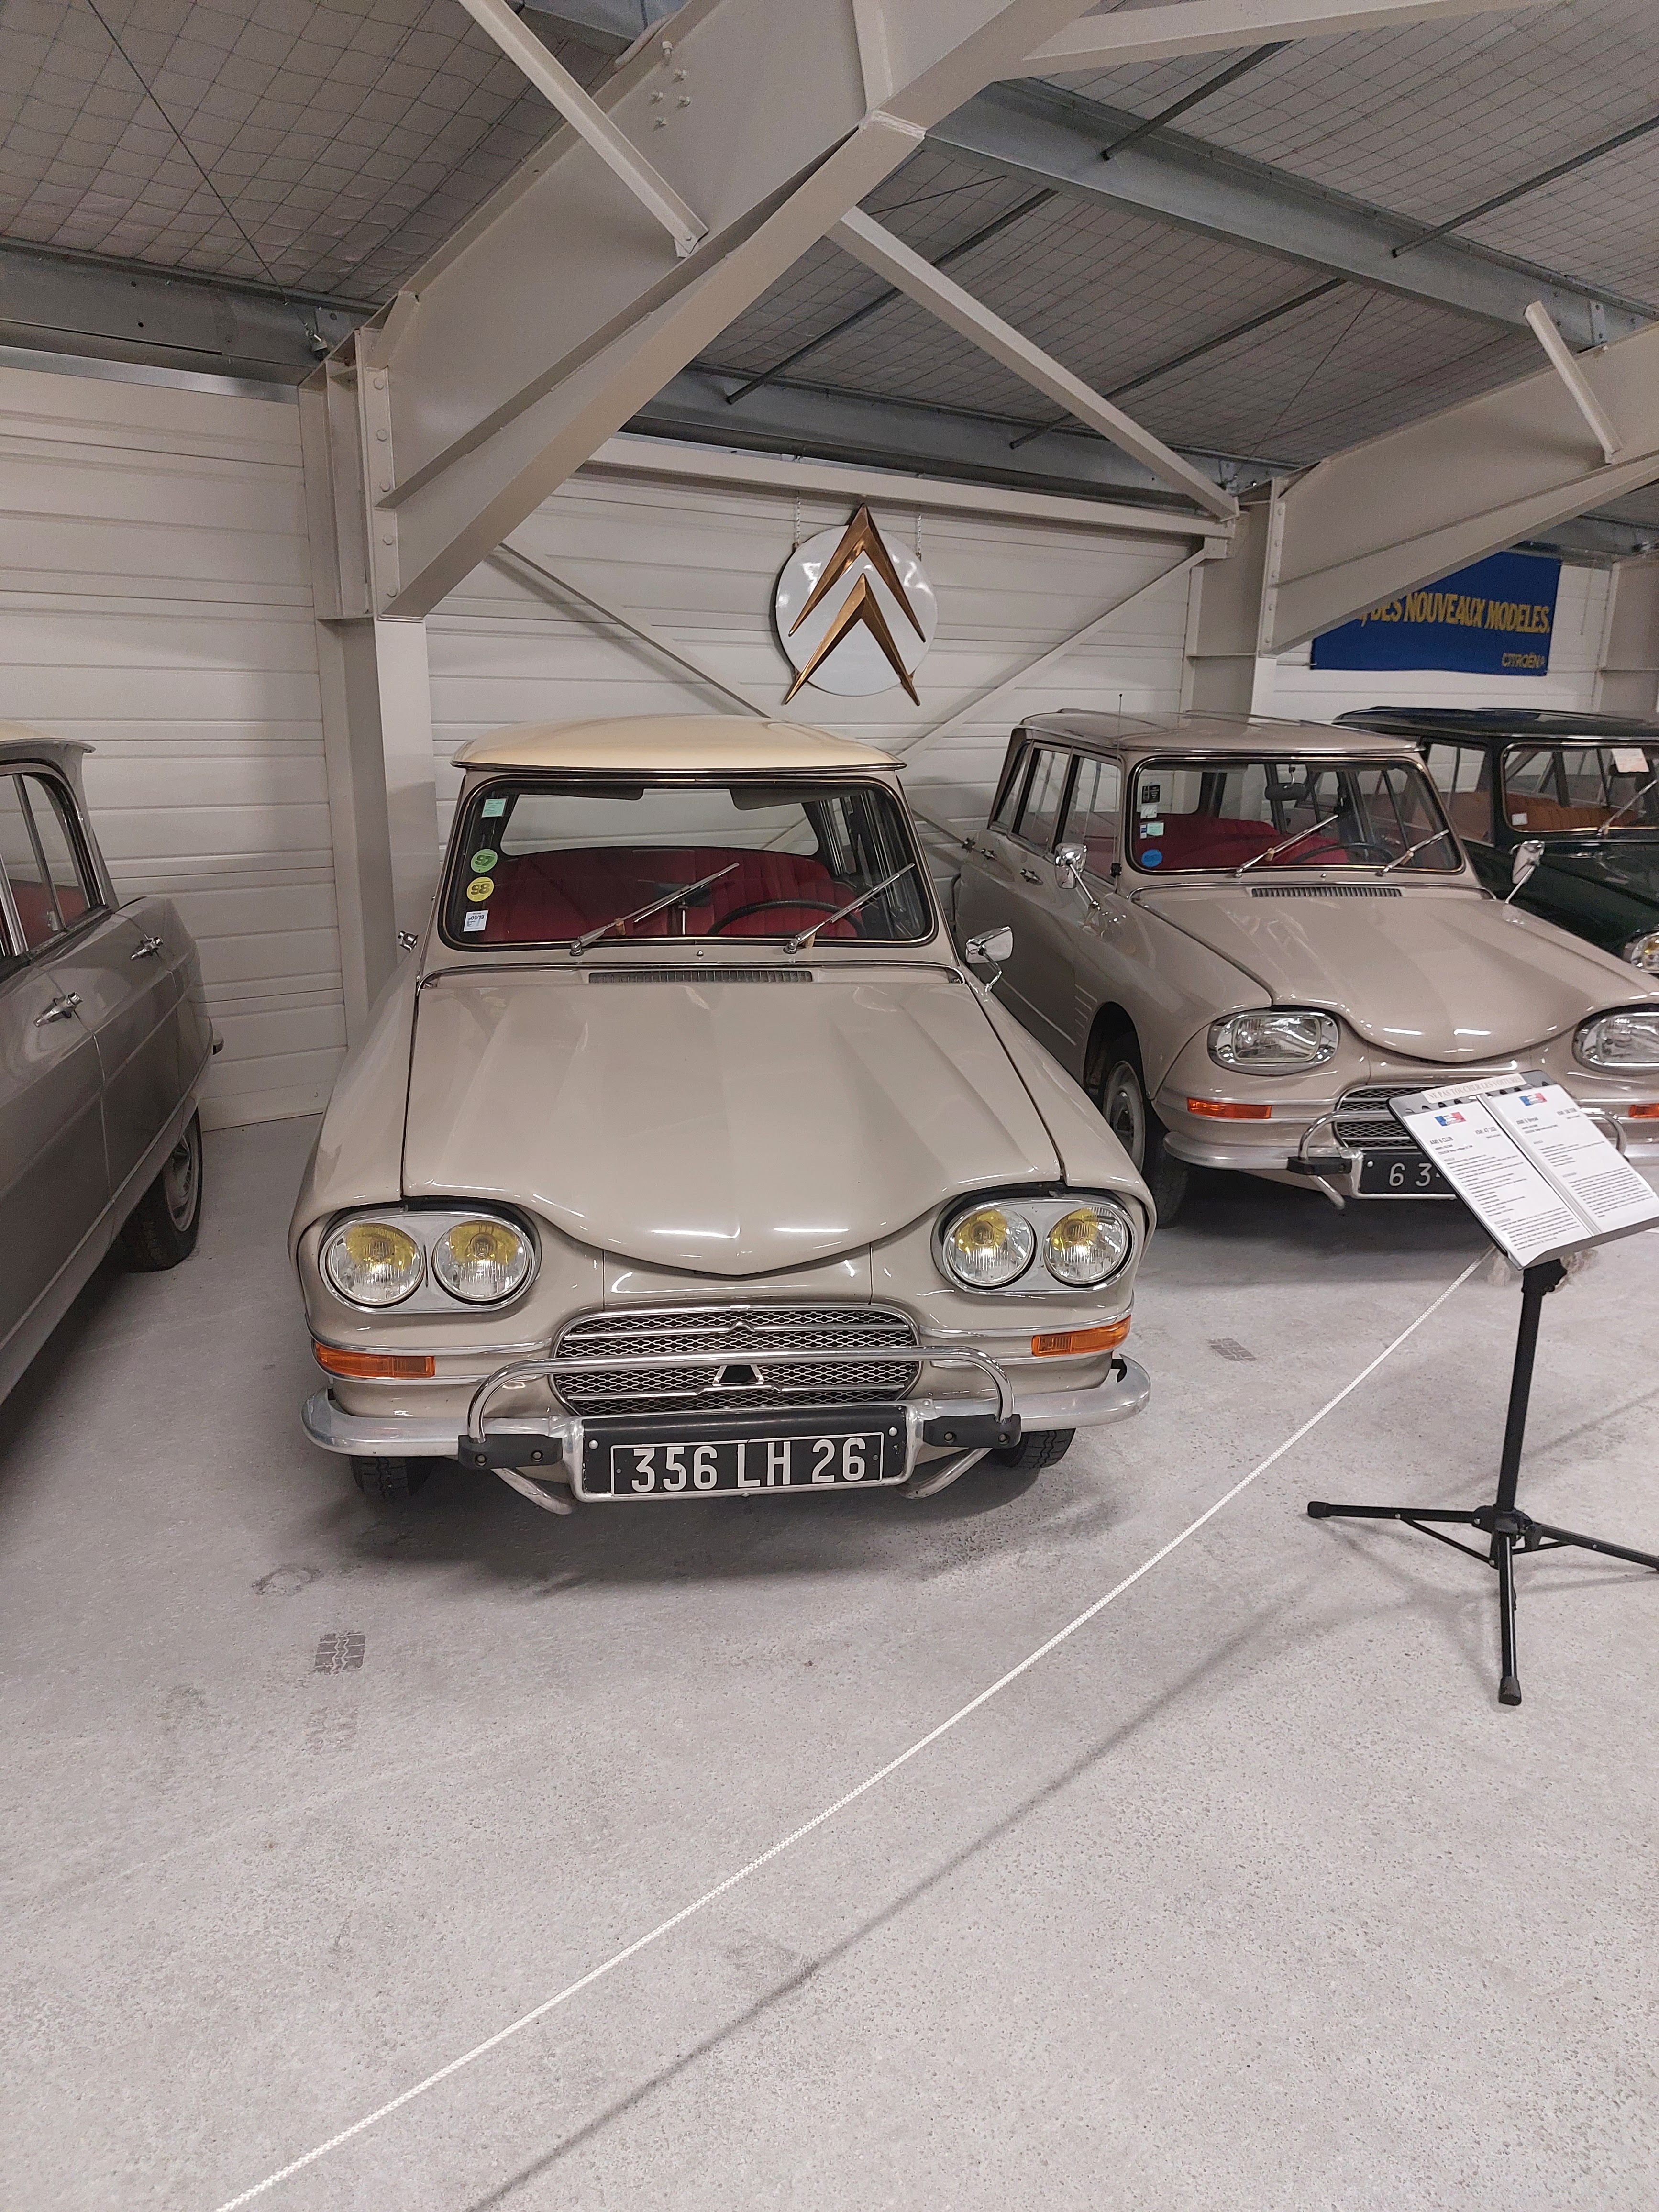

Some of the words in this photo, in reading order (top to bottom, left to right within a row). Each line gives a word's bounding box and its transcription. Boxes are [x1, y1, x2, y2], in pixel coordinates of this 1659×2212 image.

[1404, 592, 1484, 627] NOUVEAUX
[475, 855, 495, 866] 97
[471, 883, 490, 895] 98
[1438, 1090, 1451, 1098] PAS
[1450, 1084, 1482, 1096] TOUCHER
[1481, 1081, 1494, 1090] LES
[1492, 1076, 1523, 1088] VOITURES
[1389, 1162, 1440, 1187] 63
[631, 1446, 717, 1492] 356
[737, 1441, 791, 1488] LH
[812, 1438, 866, 1483] 26
